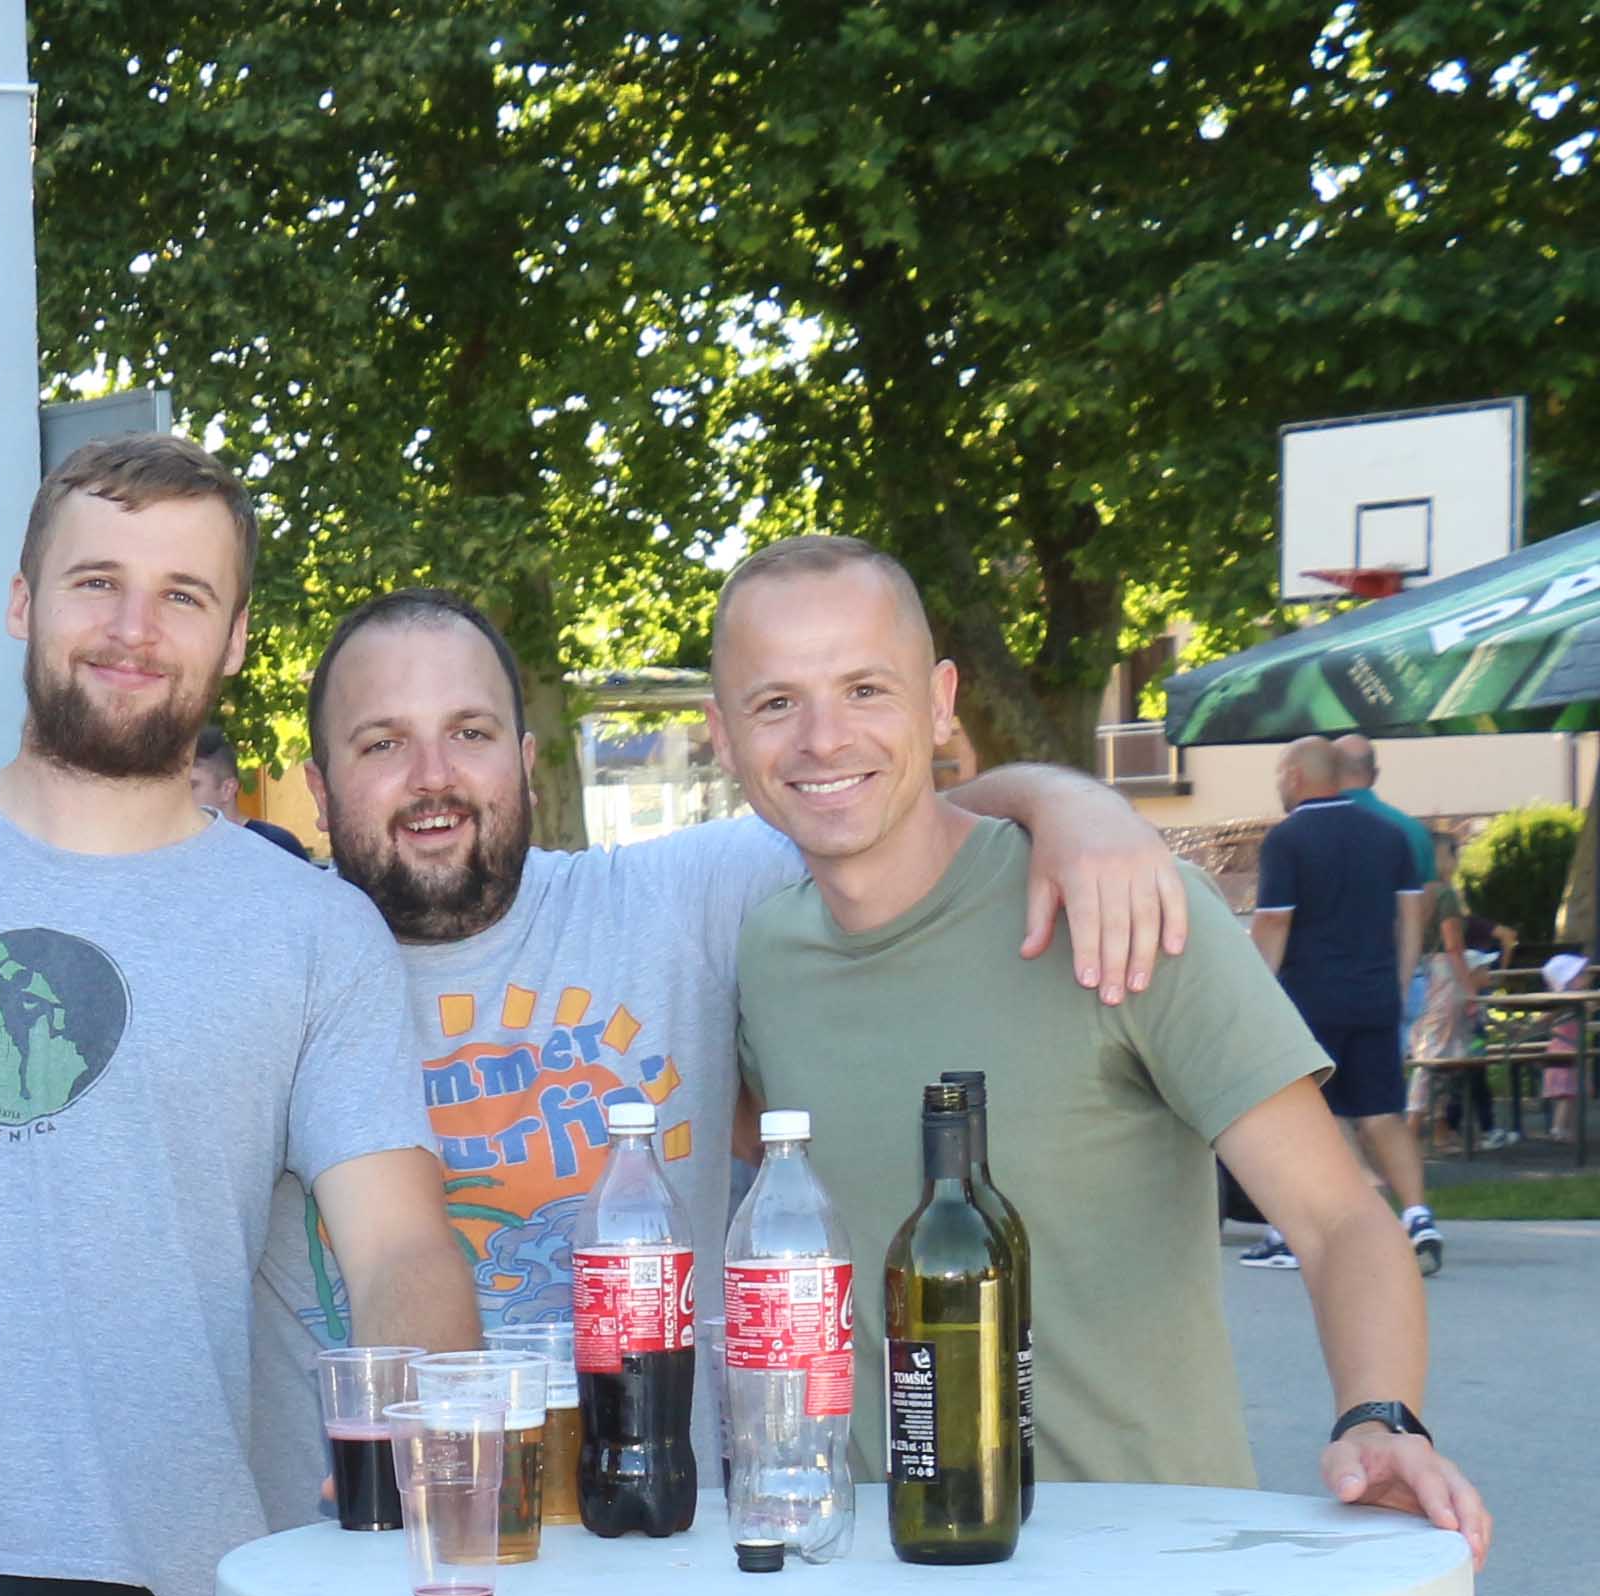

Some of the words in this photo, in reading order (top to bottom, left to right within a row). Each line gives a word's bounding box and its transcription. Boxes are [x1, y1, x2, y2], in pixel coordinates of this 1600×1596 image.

[423, 1020, 605, 1107] mmer
[664, 1256, 674, 1279] ME
[825, 1268, 835, 1292] ME
[664, 1283, 675, 1349] RECYCLE
[893, 1371, 933, 1386] TOMŠIĆ
